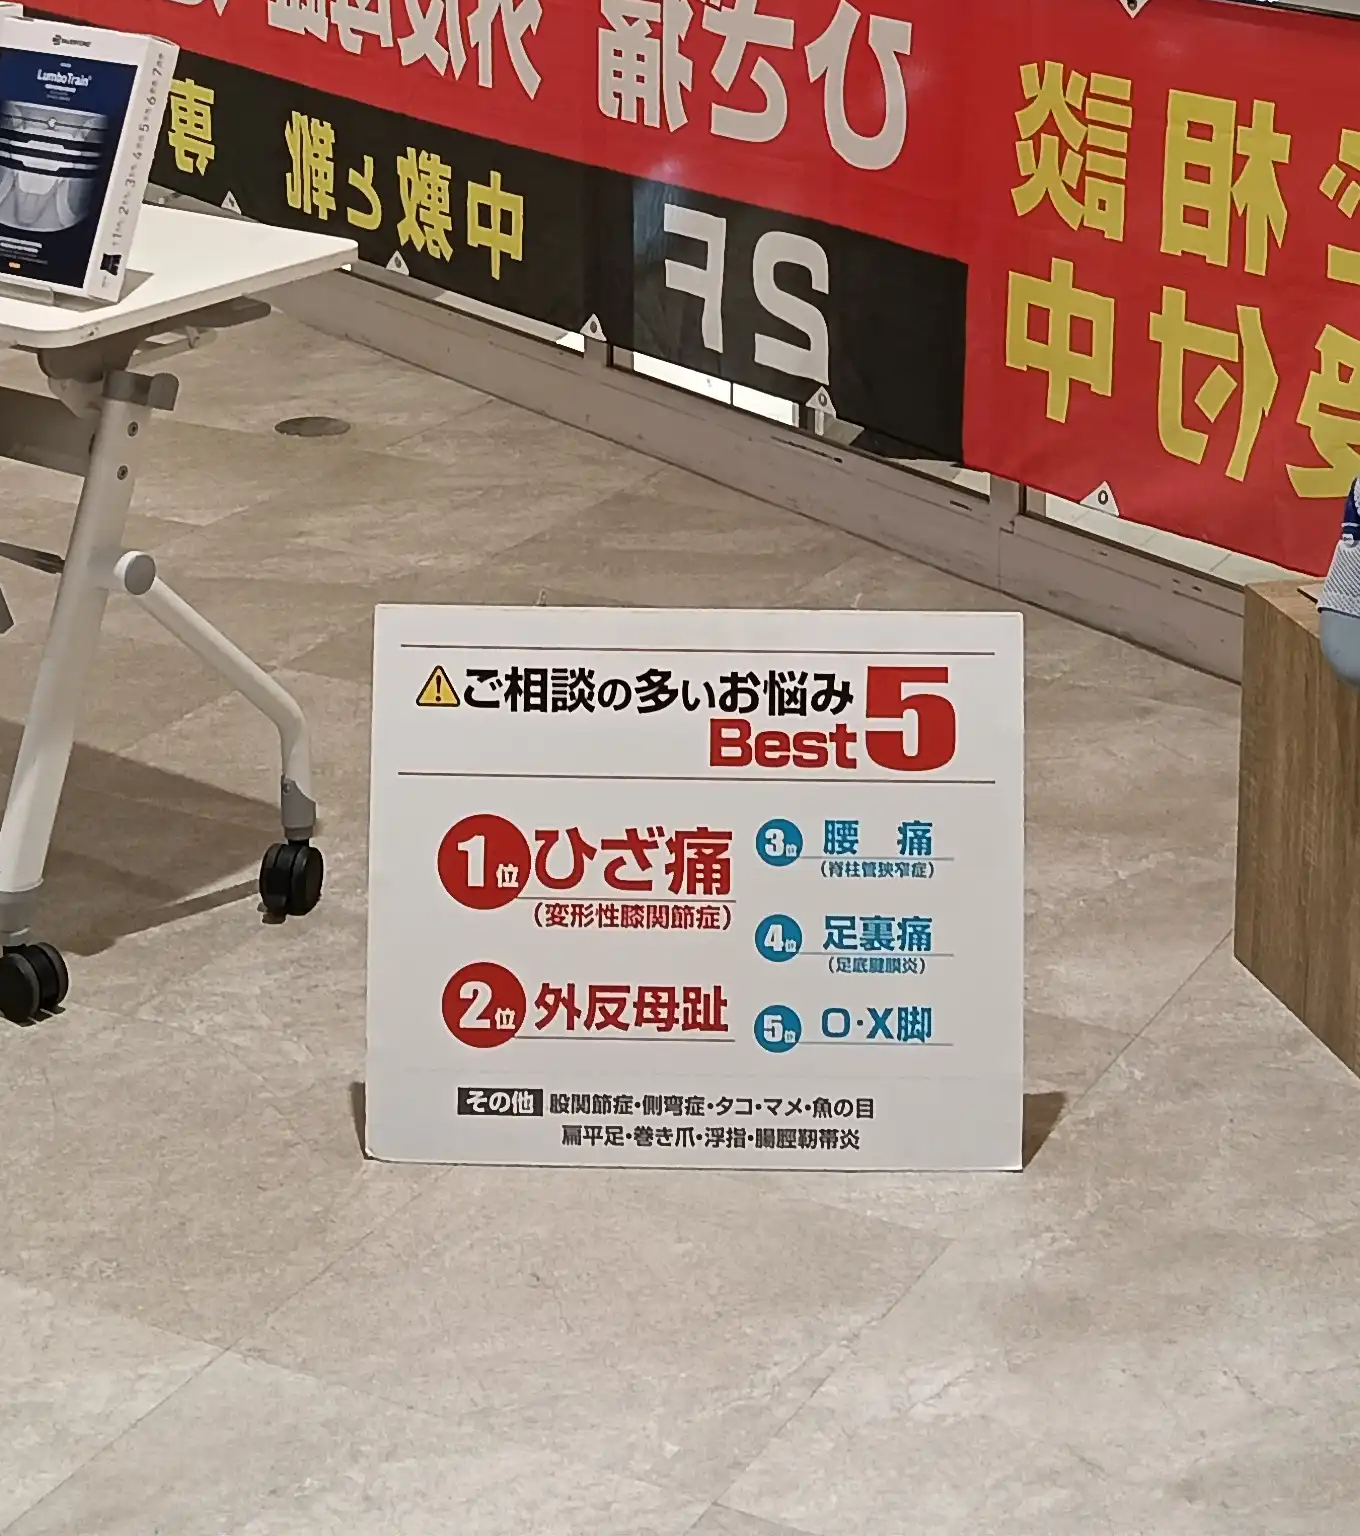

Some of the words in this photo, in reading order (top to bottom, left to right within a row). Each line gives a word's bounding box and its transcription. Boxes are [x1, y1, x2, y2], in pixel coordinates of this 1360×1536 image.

[463, 666, 854, 716] ご相談の多いお悩み
[710, 718, 857, 769] Best
[865, 665, 956, 772] 5
[535, 825, 733, 896] ひざ痛
[533, 901, 732, 931] (変形性膝関節症)
[822, 915, 933, 952] 足裏痛
[534, 982, 729, 1033] 外反母趾
[466, 1090, 535, 1114] その他
